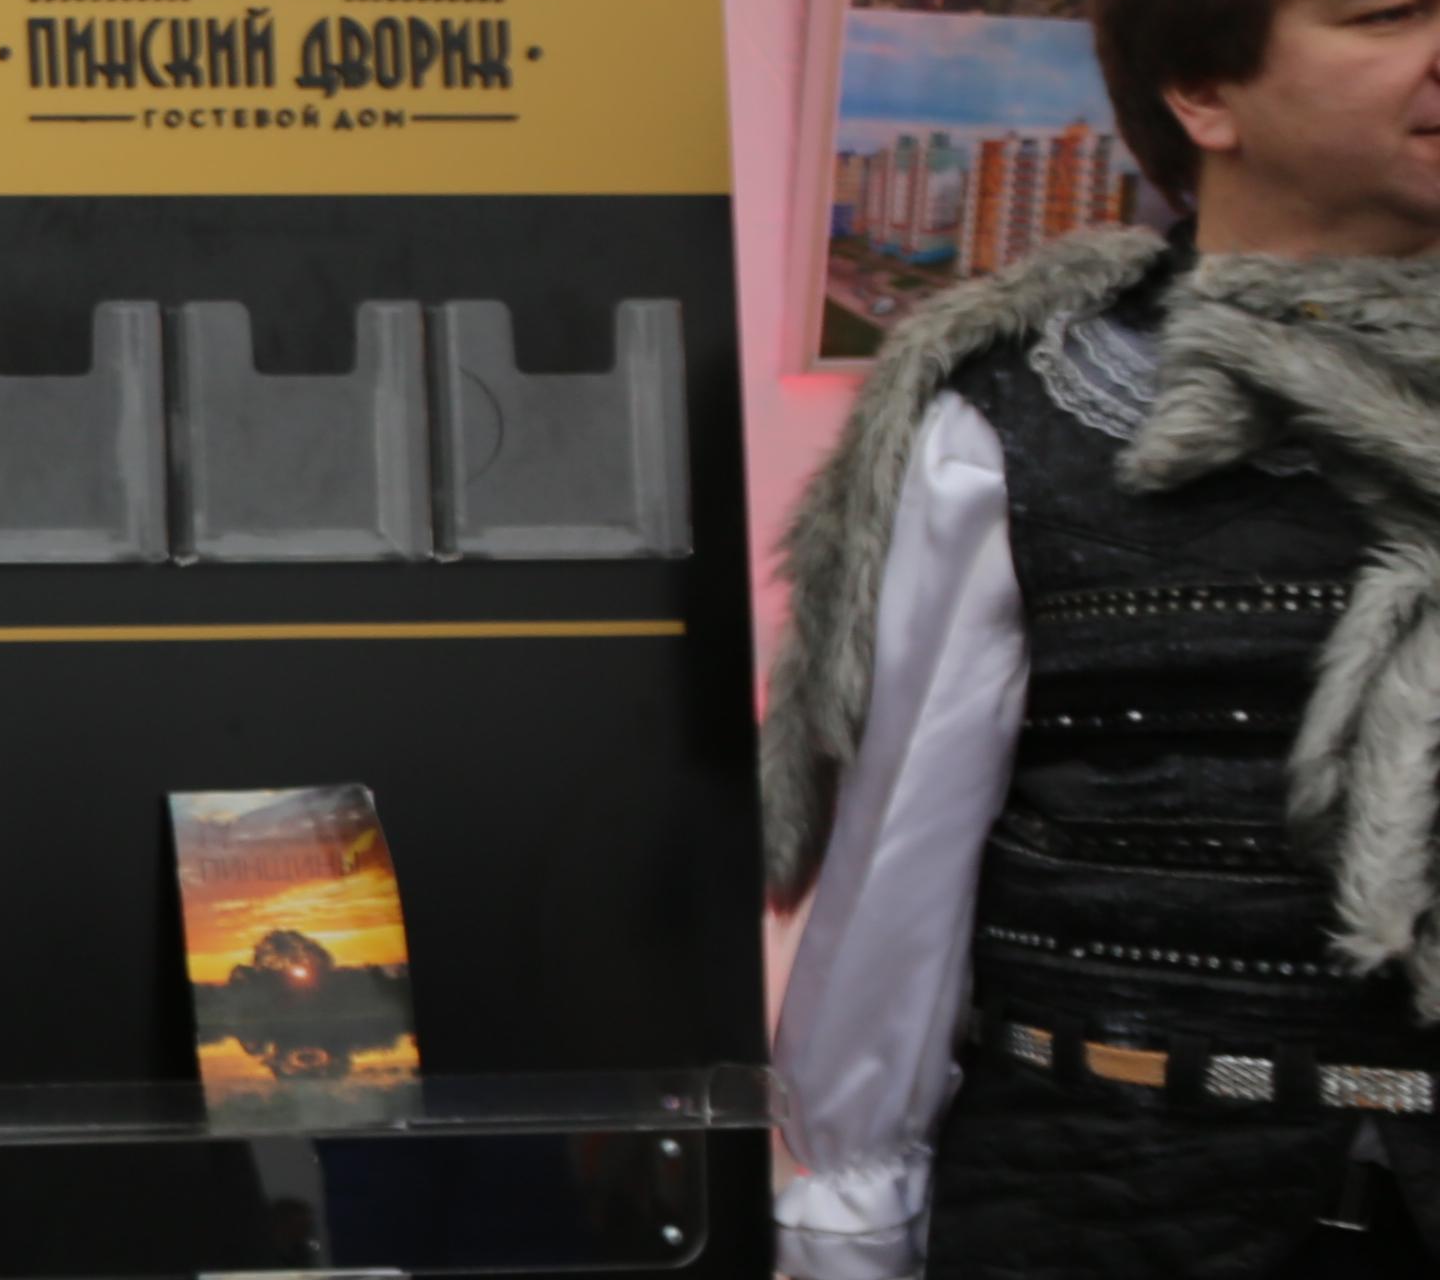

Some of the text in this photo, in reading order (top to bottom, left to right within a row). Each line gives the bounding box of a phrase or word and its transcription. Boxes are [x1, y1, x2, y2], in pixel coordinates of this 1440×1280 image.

[27, 7, 513, 98] ПИНСКИЙ ДВОРИК
[142, 104, 405, 131] ГОСТЕВОЙ ДОМ
